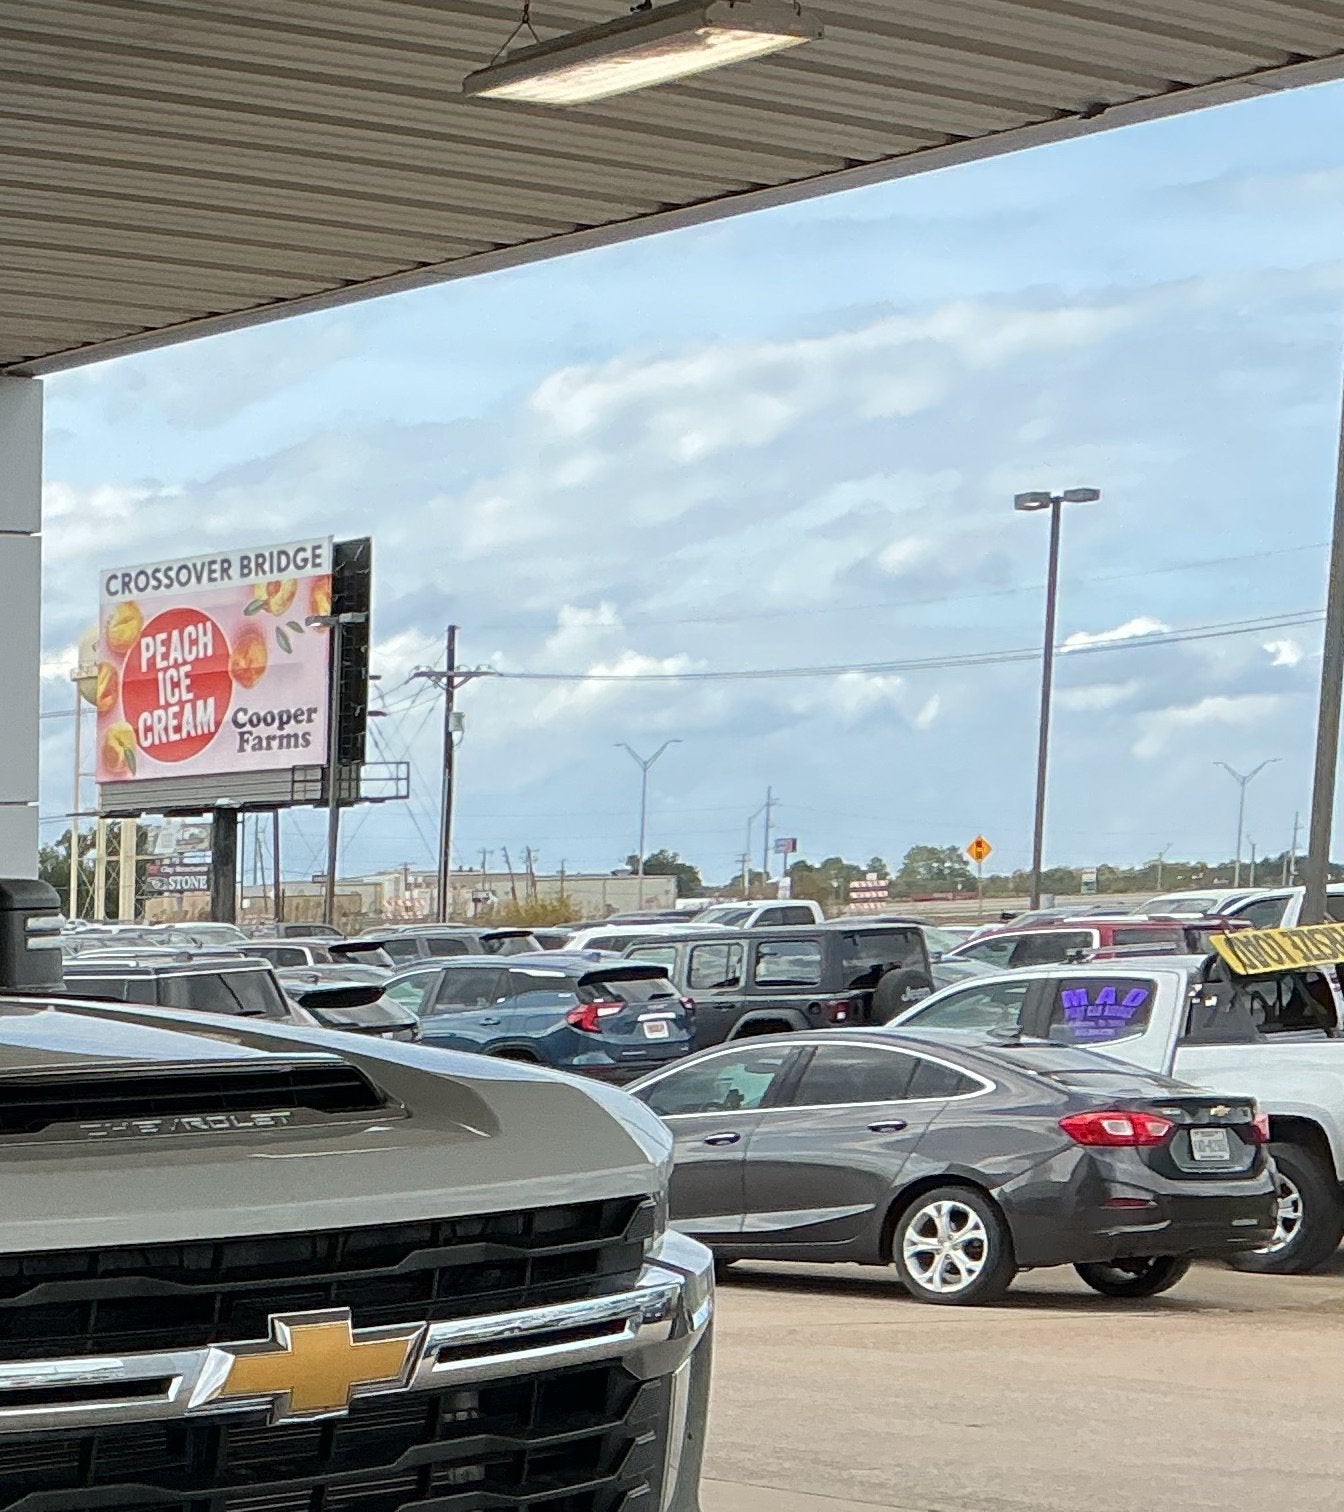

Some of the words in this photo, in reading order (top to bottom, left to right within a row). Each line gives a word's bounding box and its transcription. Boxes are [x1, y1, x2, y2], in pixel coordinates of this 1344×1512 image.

[105, 557, 233, 597] CROSSOVER
[239, 544, 323, 578] BRIDGE
[140, 620, 213, 672] PEACH
[157, 664, 194, 706] ICE
[137, 697, 216, 748] CREAM
[231, 706, 318, 730] Cooper
[237, 730, 312, 753] Farms
[168, 875, 208, 890] STONE
